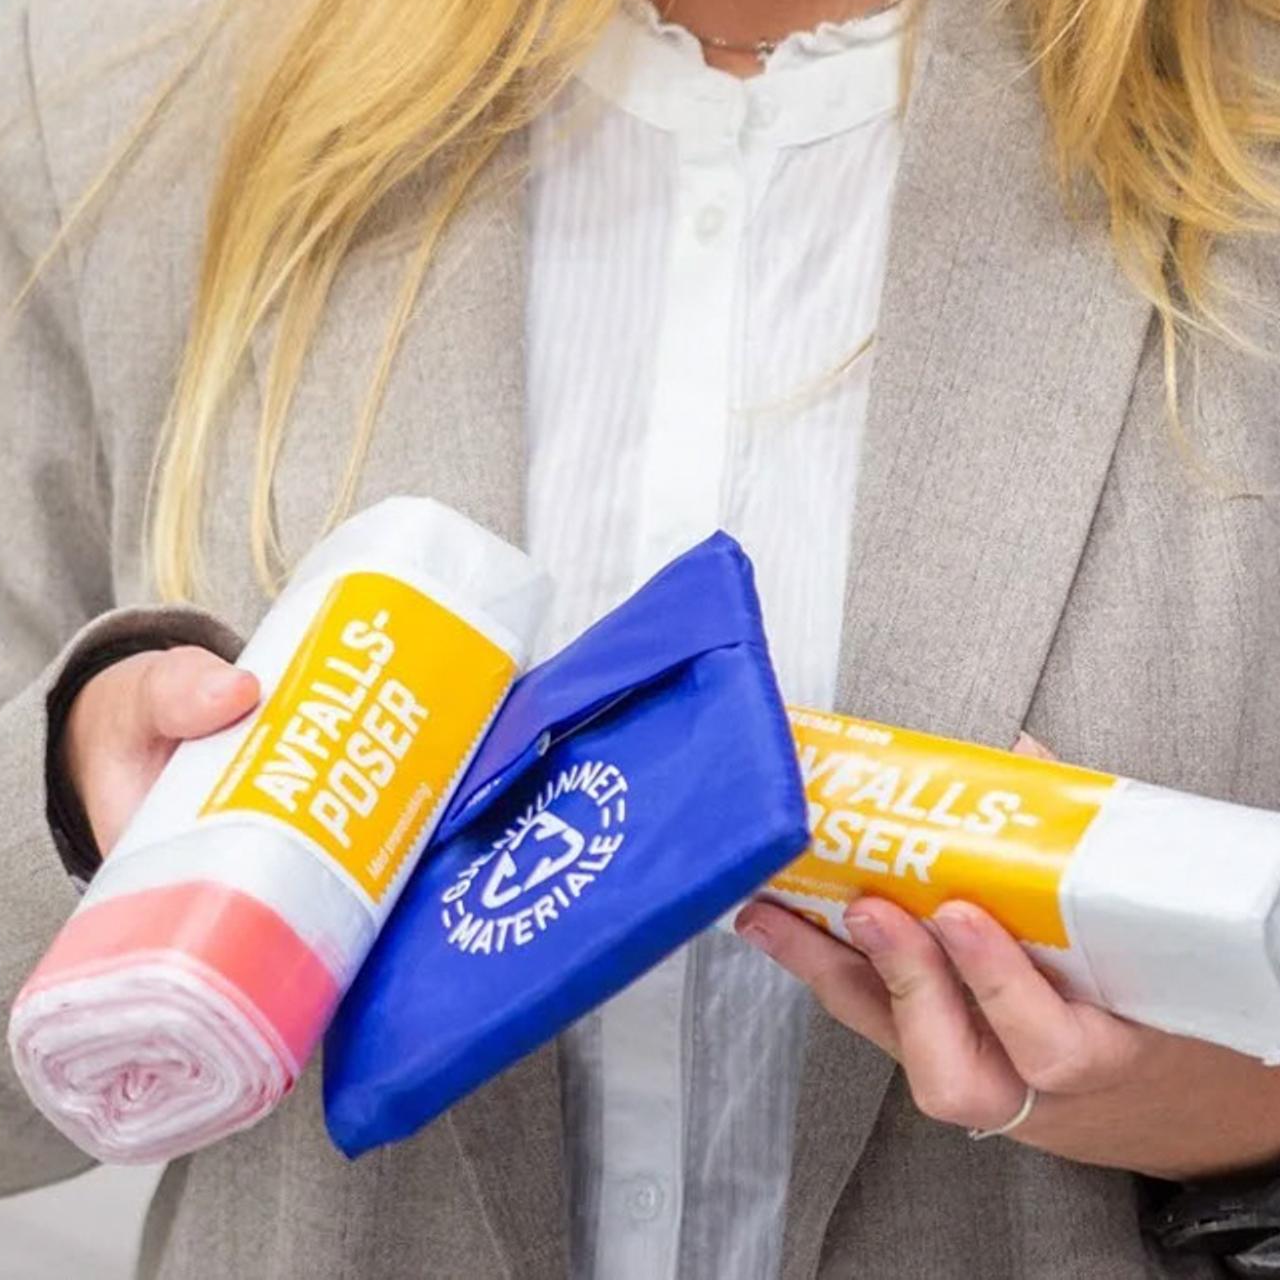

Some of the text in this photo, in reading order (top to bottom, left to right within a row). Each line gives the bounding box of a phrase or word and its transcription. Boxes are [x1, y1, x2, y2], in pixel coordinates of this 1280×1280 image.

[253, 609, 395, 813] AVFALLS-
[308, 678, 429, 849] POSER
[795, 743, 1042, 837] VFALLS-
[807, 802, 942, 884] SER
[448, 832, 625, 956] MATERIALE
